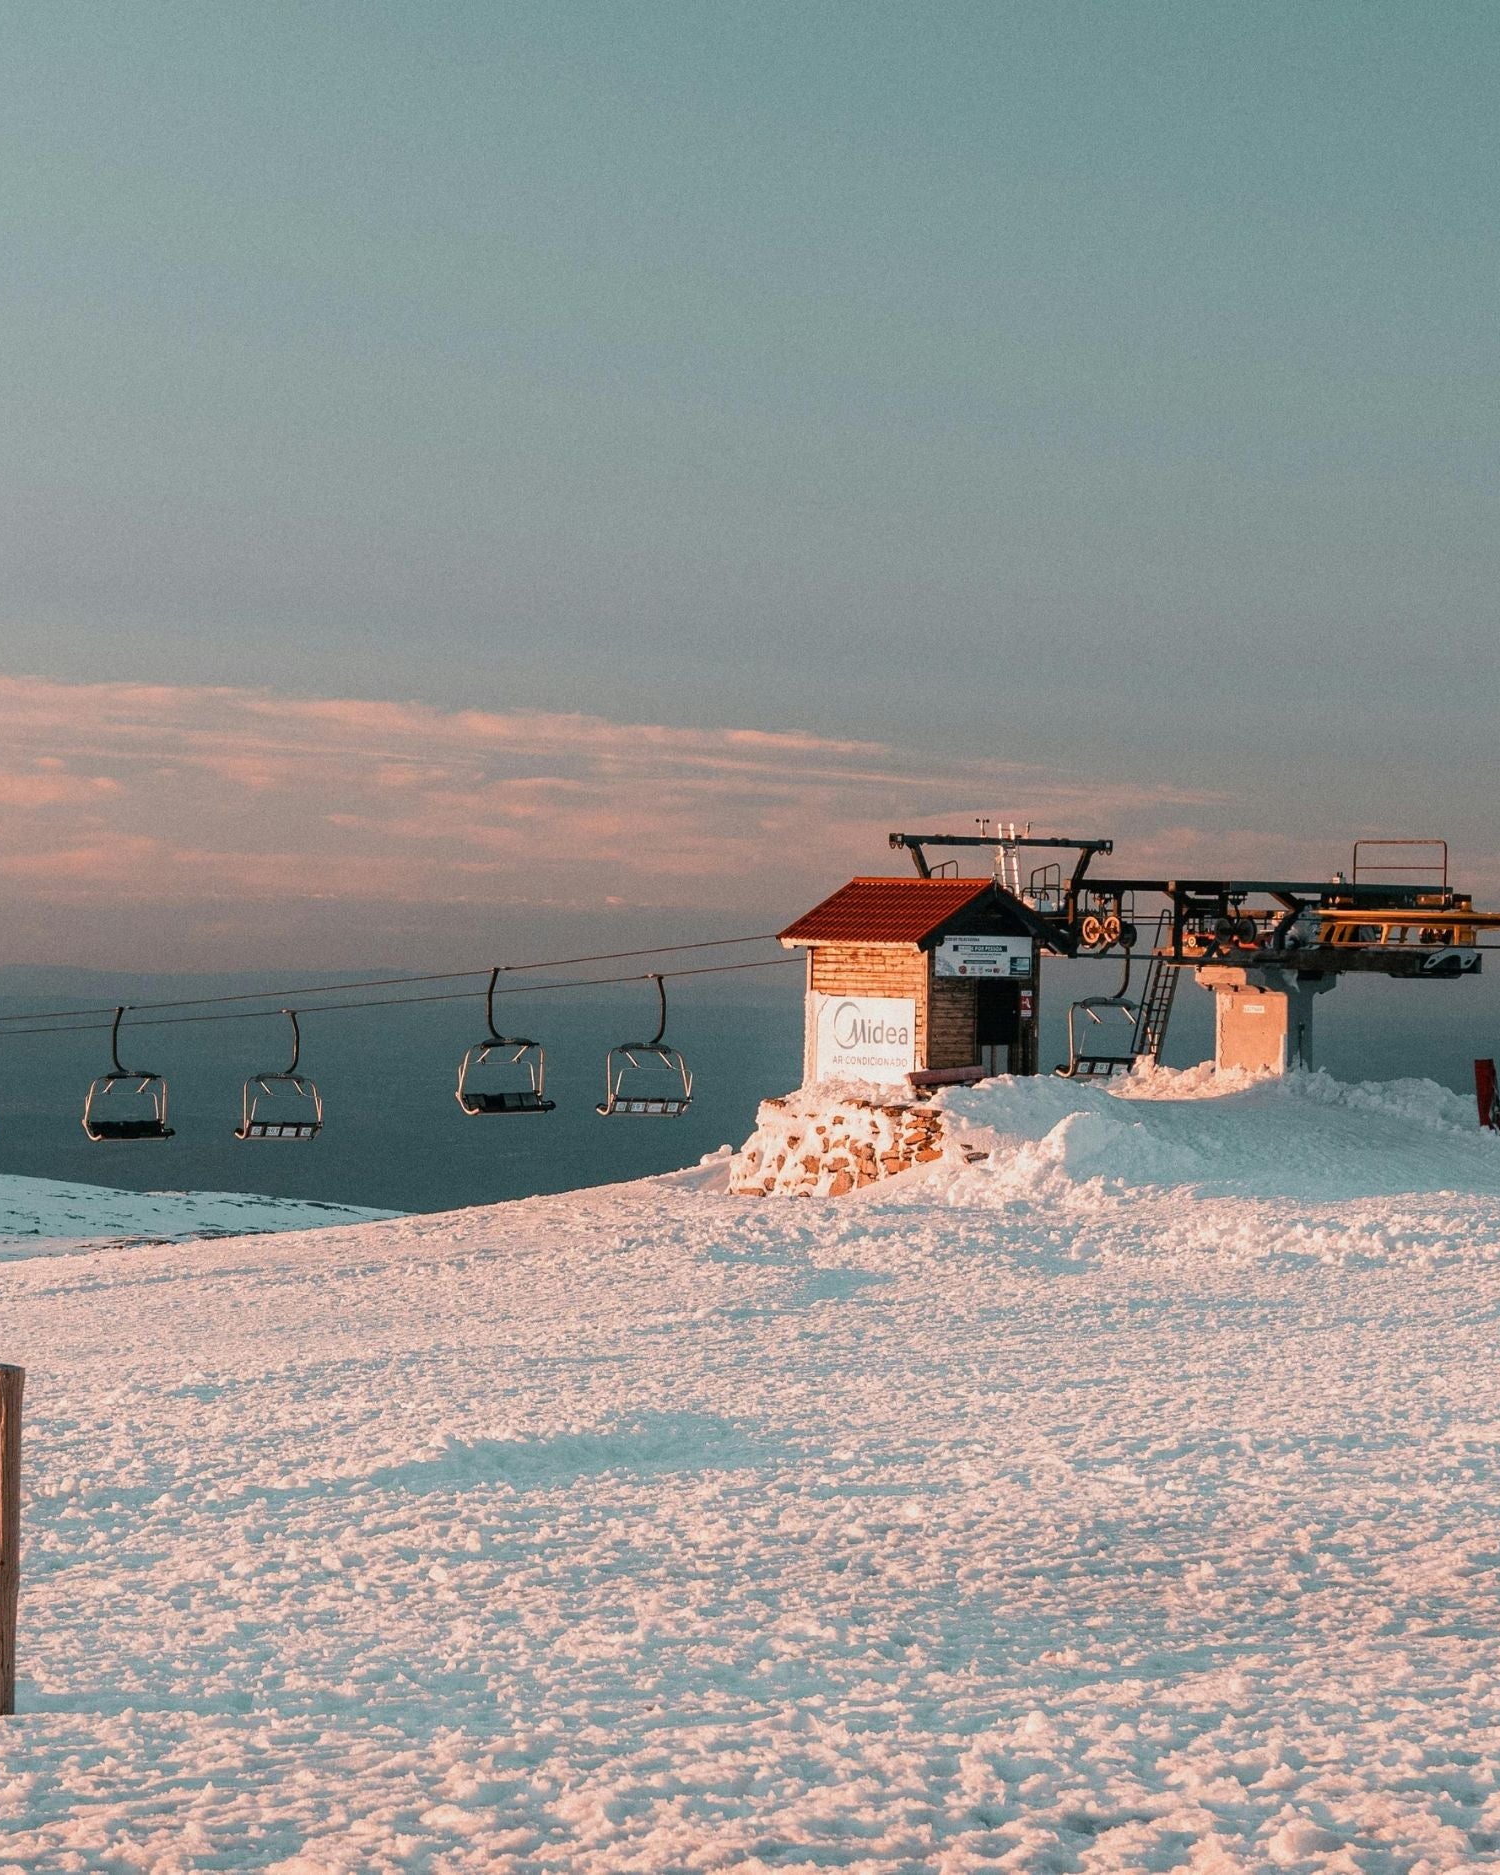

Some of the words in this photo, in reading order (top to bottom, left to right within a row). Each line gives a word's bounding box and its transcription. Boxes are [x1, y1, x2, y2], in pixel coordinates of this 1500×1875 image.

[834, 1001, 908, 1049] Midea
[833, 1055, 843, 1065] AR
[845, 1056, 908, 1067] CONDICIONADO
